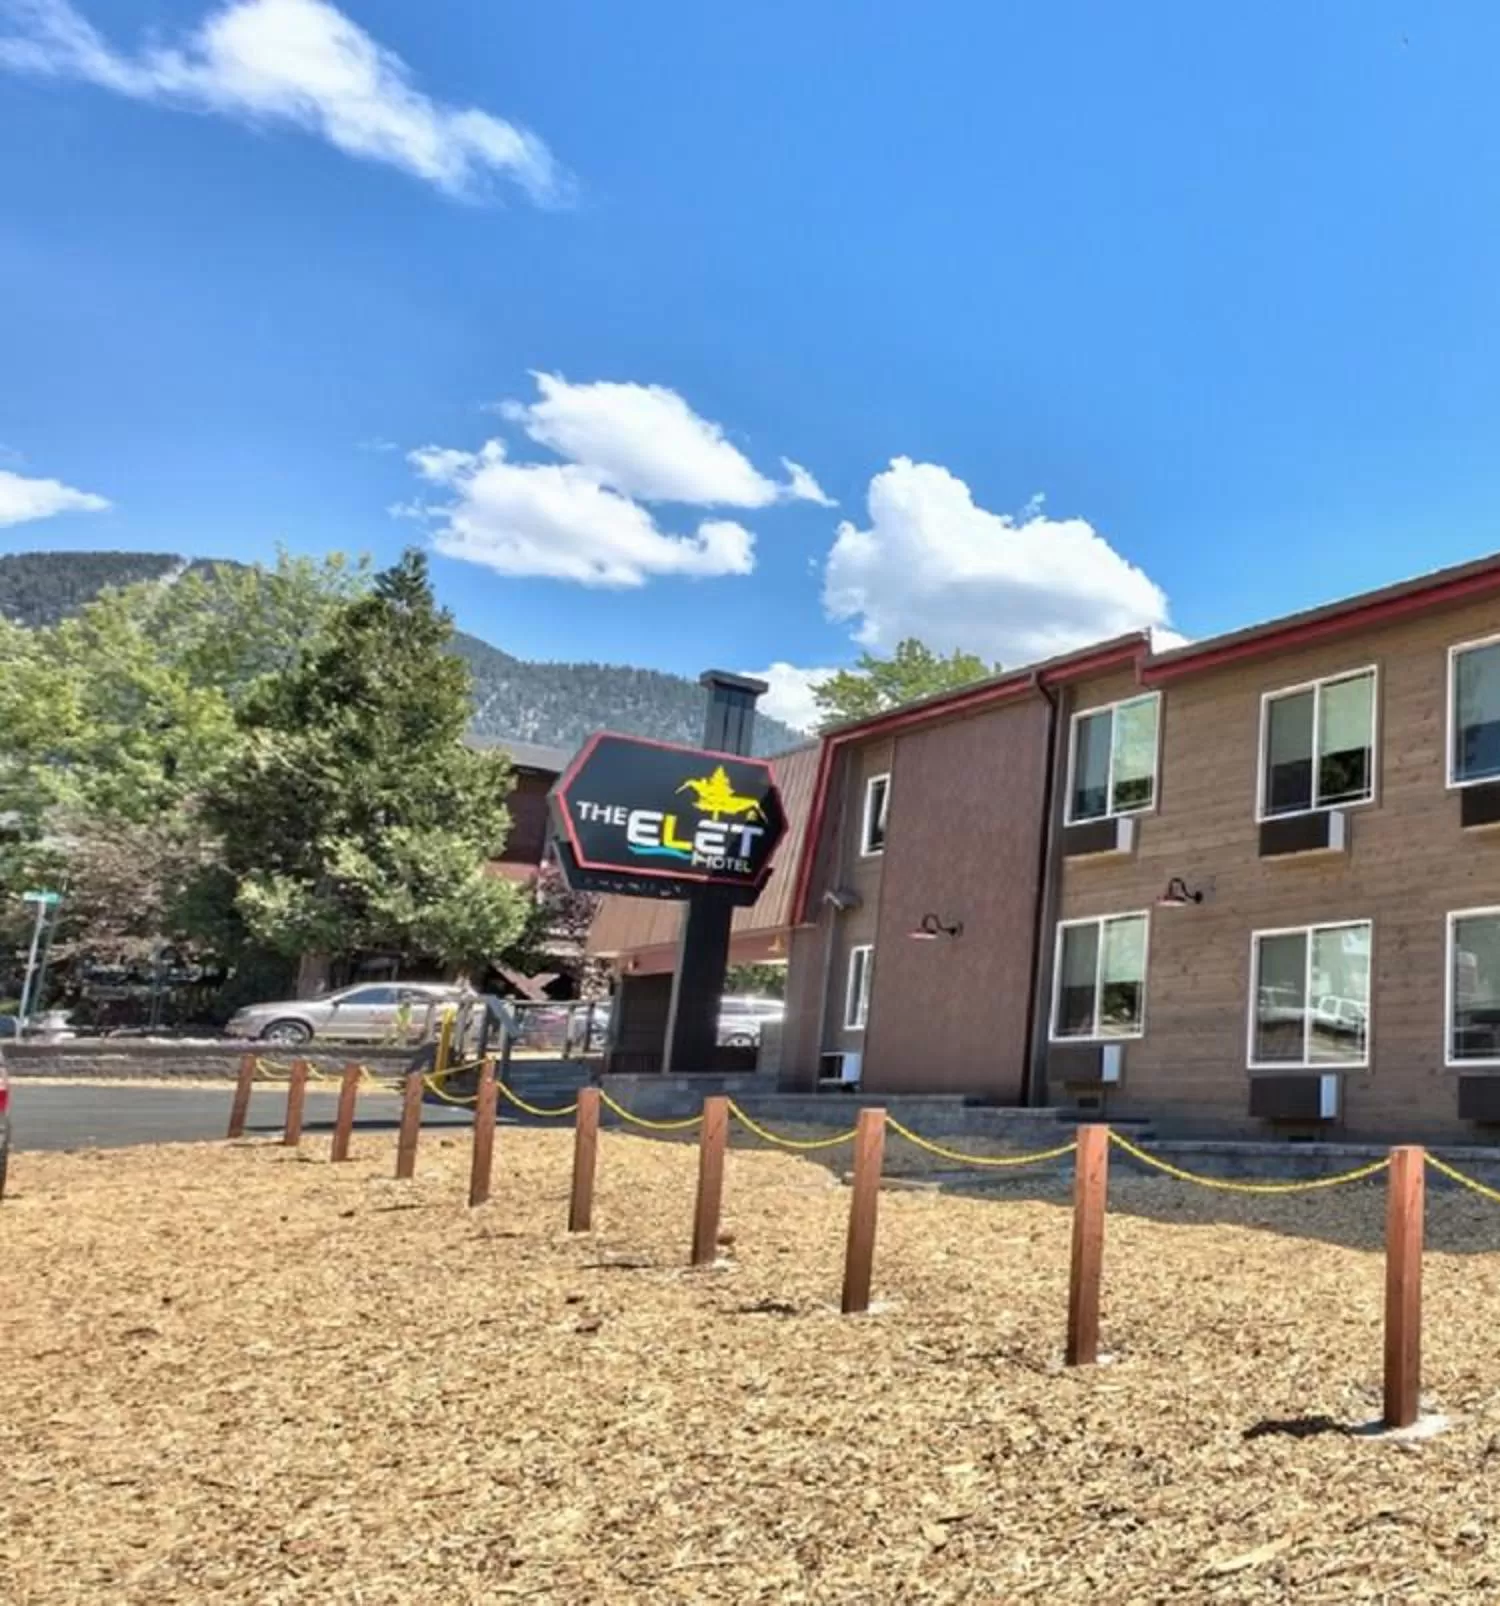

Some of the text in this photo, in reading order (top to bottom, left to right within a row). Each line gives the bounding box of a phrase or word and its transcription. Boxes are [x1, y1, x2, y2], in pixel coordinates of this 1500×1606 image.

[576, 800, 764, 857] THE ELET
[691, 851, 752, 873] HOTEL
